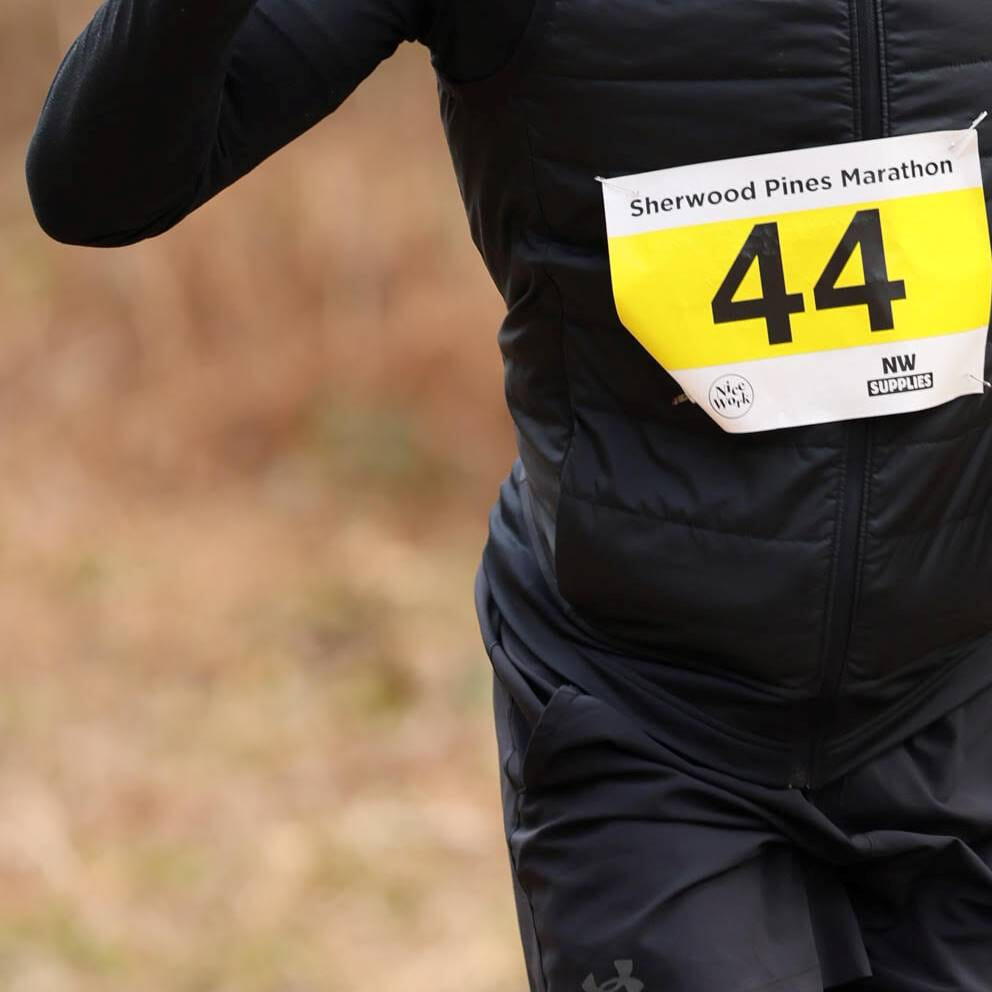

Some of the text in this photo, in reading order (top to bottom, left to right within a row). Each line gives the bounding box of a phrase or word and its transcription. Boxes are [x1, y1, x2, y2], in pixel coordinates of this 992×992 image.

[630, 157, 954, 217] Sherwood Pines Marathon
[711, 208, 907, 346] 44
[882, 354, 916, 374] NW
[715, 380, 746, 397] Nice
[868, 373, 933, 395] SUPPLIES
[713, 395, 750, 410] Work
